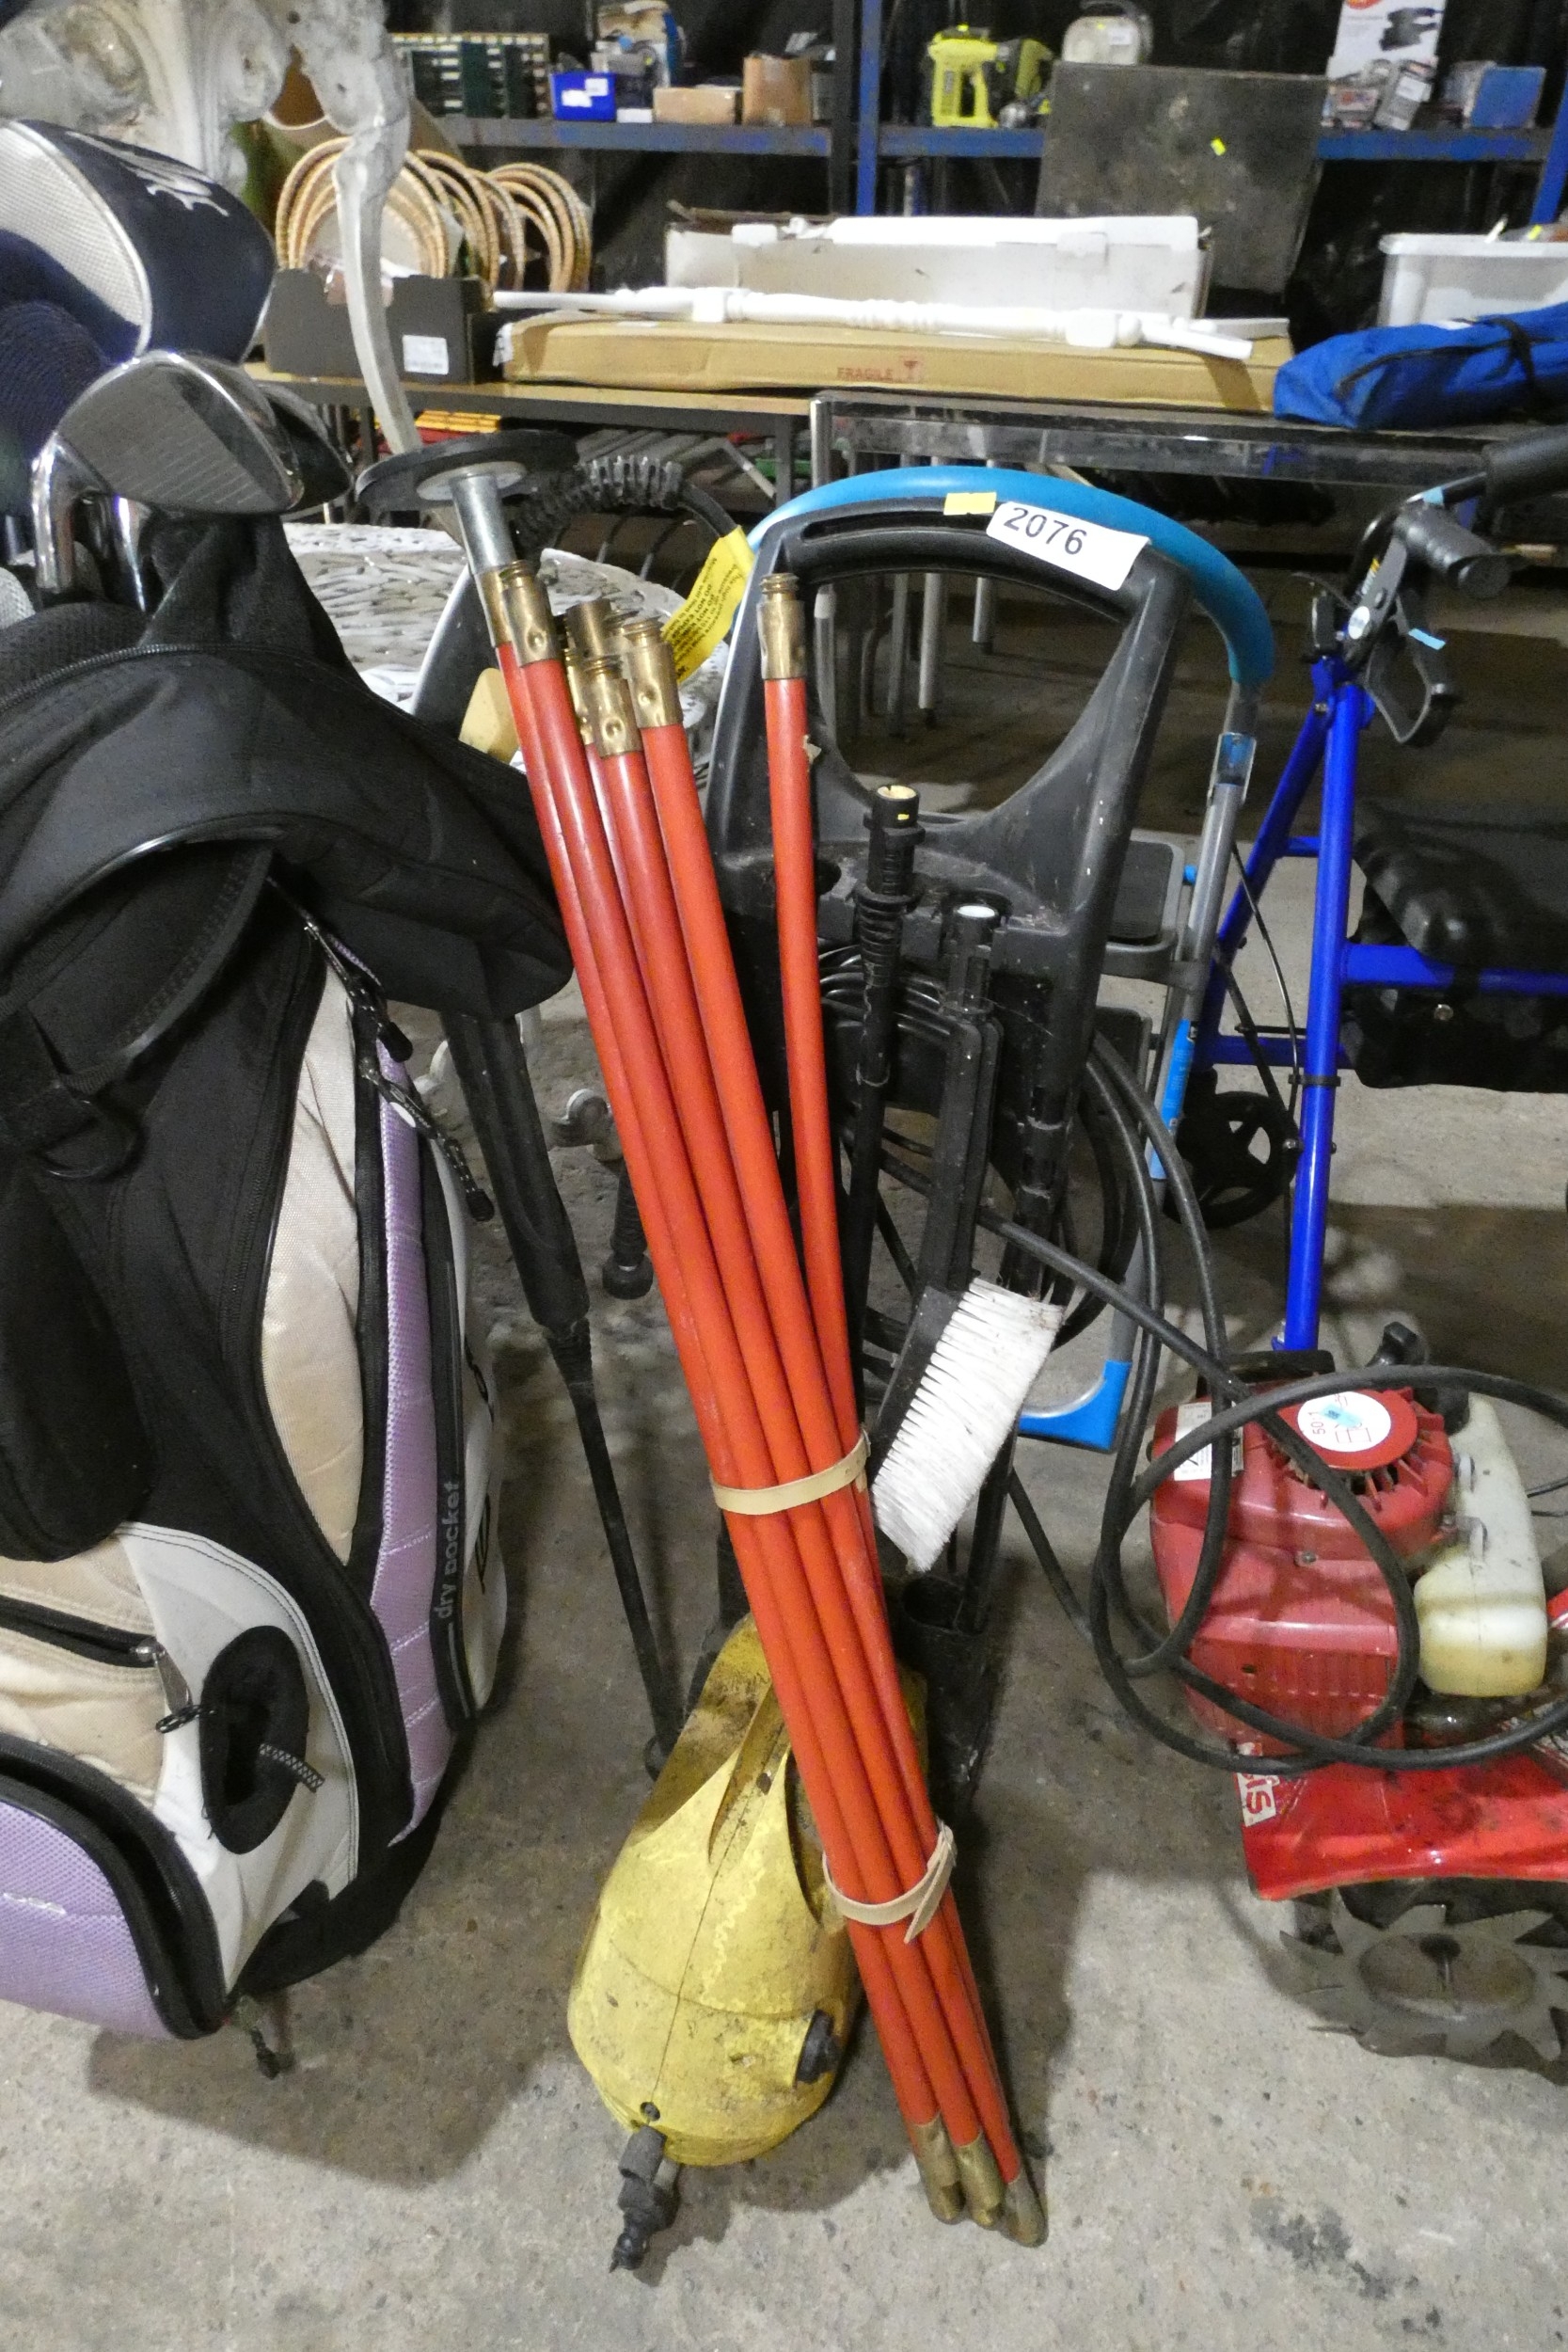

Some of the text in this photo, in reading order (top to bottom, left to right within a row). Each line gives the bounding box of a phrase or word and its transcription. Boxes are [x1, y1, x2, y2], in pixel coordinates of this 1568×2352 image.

[836, 368, 894, 384] FRAGILE
[1004, 507, 1087, 555] 2076
[434, 1583, 456, 1618] dry
